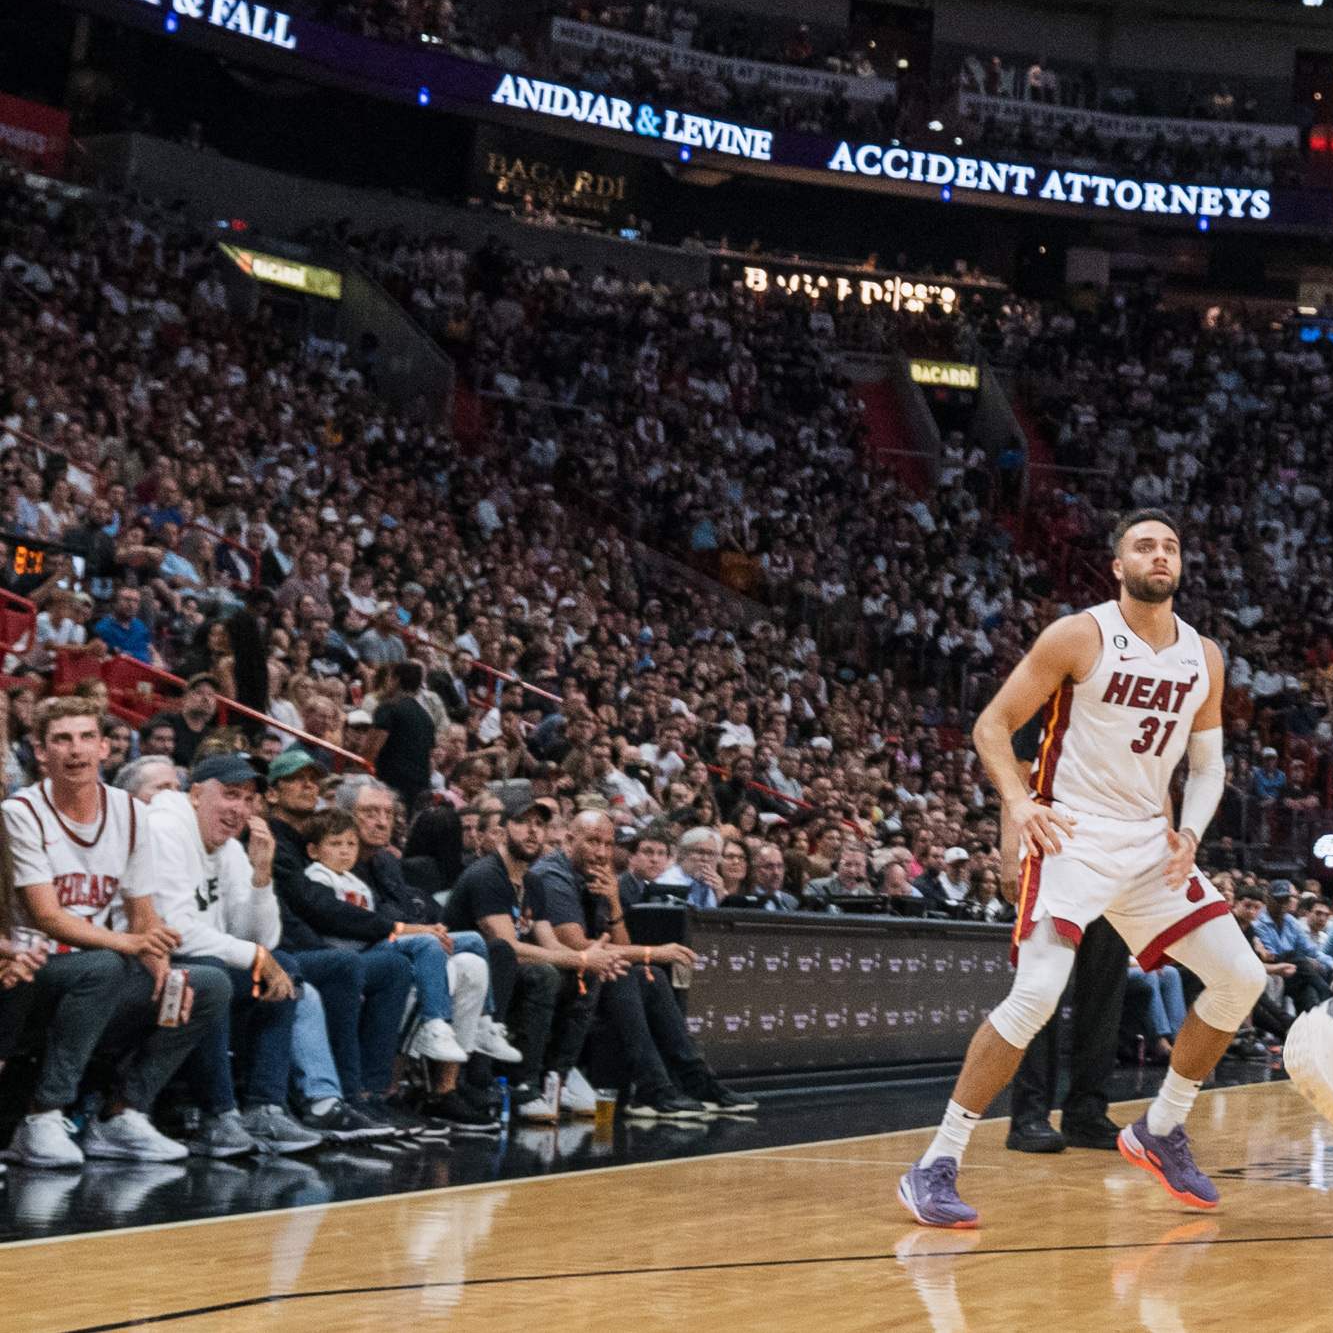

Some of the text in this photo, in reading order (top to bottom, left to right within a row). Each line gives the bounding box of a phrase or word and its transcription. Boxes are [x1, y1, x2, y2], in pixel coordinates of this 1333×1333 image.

[492, 73, 774, 162] ANIDJAR & LEVINE
[828, 141, 1271, 221] ACCIDENT ATTORNEYS
[1102, 671, 1199, 714] HEAT
[1130, 716, 1178, 757] 31
